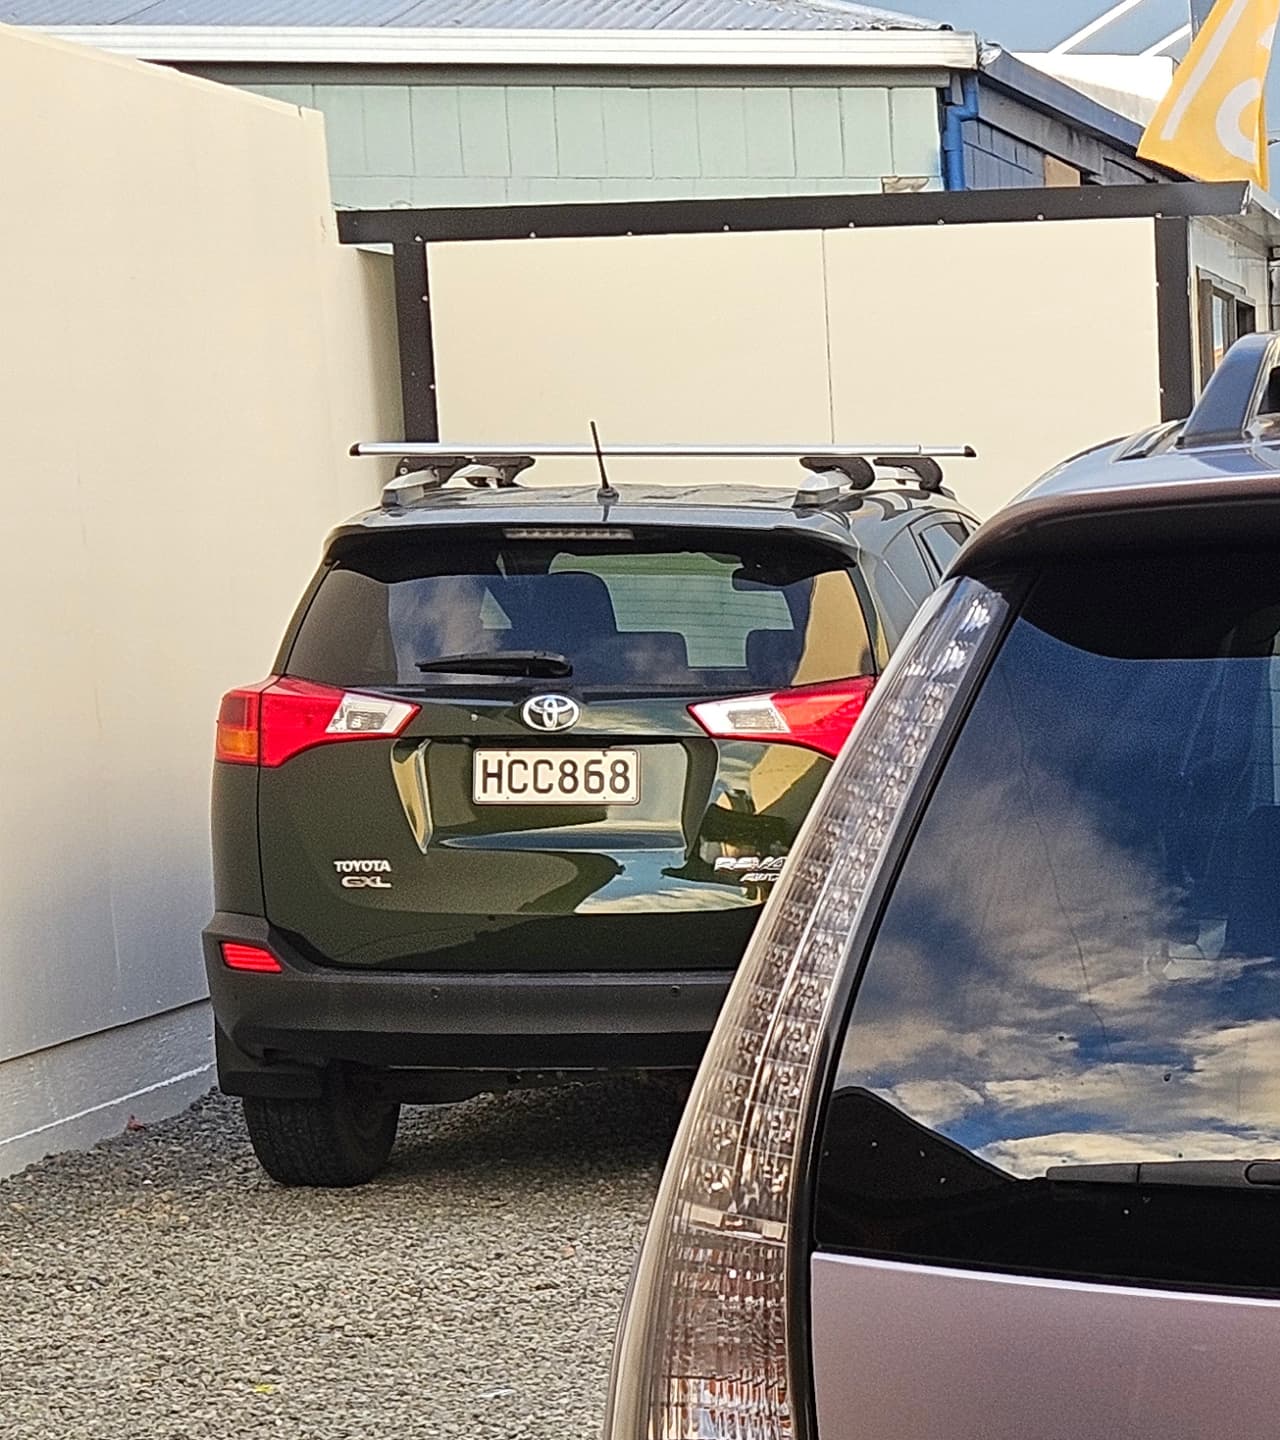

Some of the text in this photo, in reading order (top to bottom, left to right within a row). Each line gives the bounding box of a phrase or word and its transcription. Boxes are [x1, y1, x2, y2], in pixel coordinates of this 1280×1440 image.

[482, 759, 630, 794] HCC868
[333, 860, 392, 872] TOYOTA
[341, 876, 392, 888] GXL
